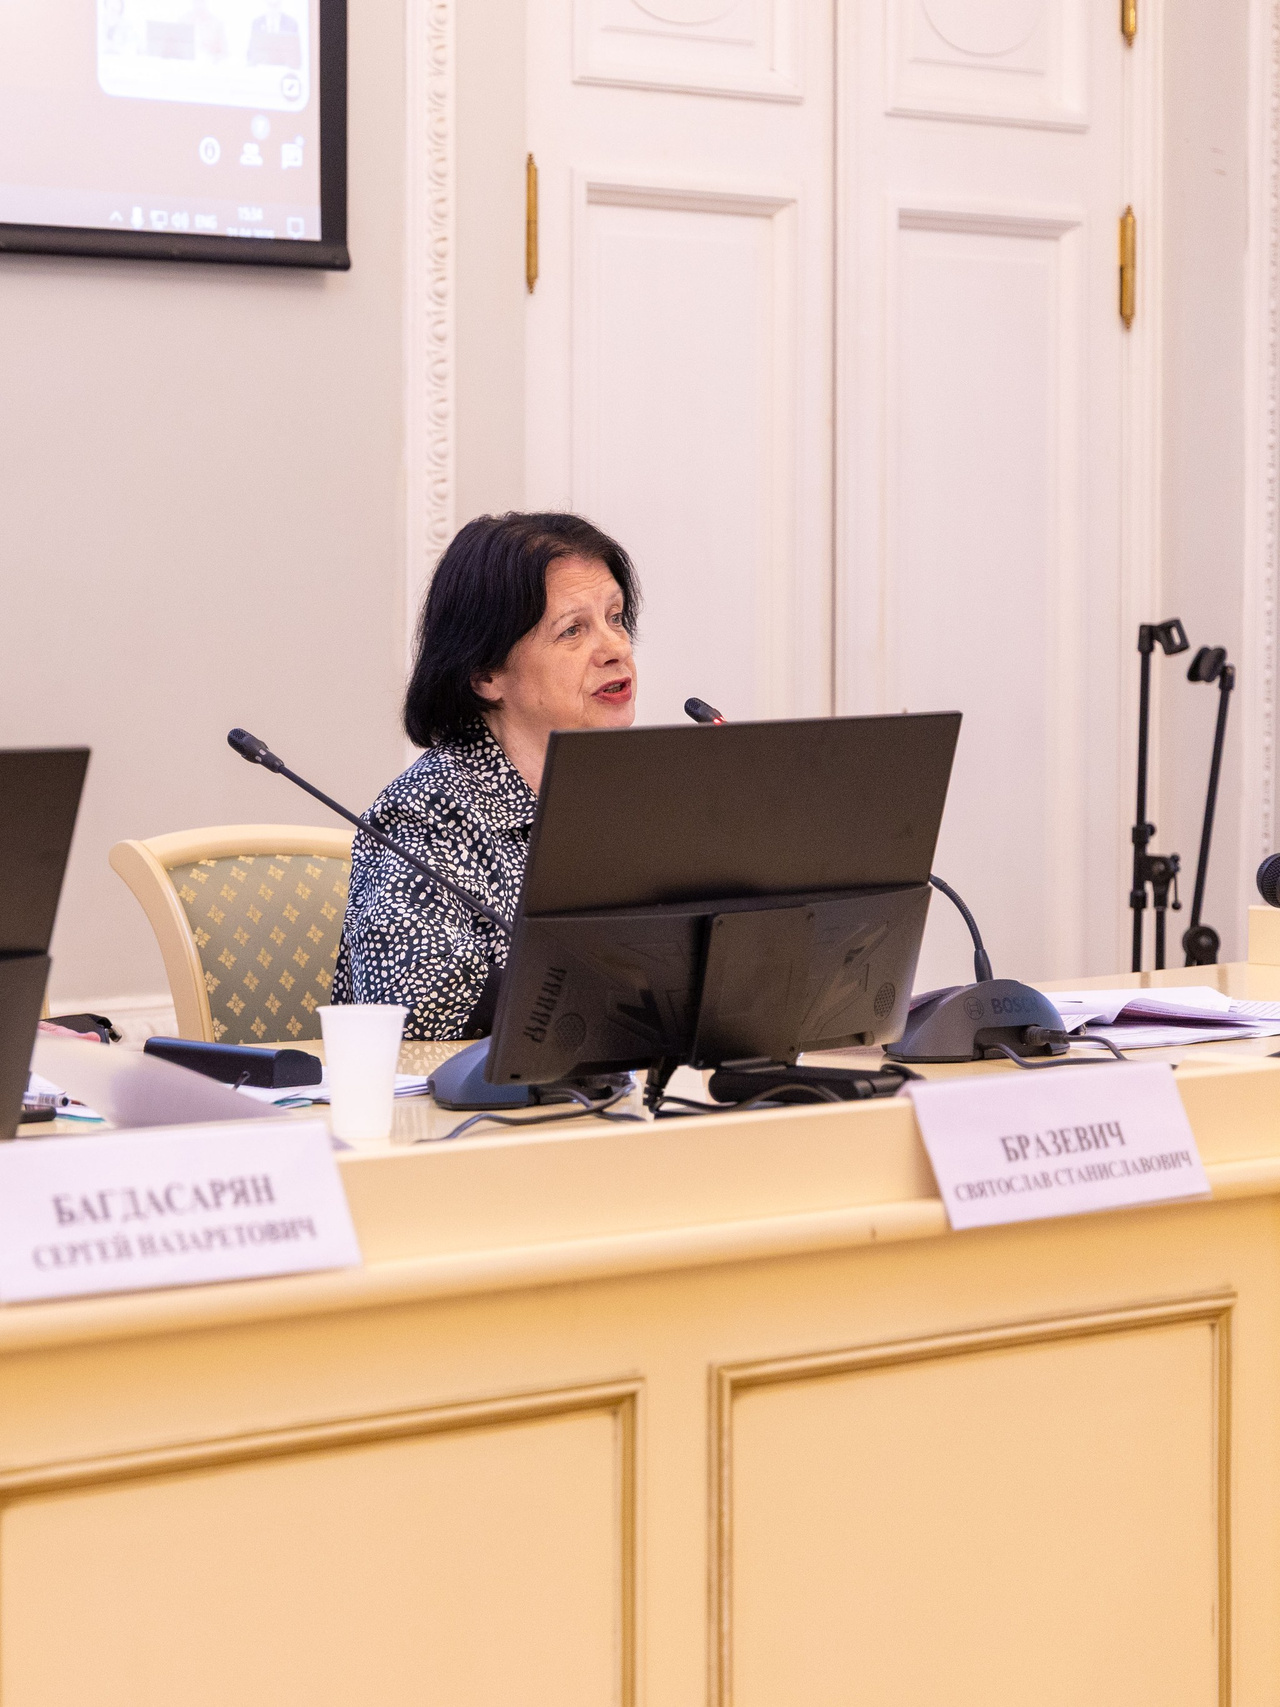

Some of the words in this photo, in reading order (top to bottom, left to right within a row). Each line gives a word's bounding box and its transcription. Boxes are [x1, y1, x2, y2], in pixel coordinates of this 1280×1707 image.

[991, 996, 1038, 1014] BOSCH
[1000, 1121, 1127, 1163] БРАЗЕВИЧ
[52, 1173, 276, 1226] БАГДАСАРЯН
[954, 1169, 1054, 1202] СВЯТОСЛАВ
[1053, 1149, 1194, 1188] СТАНИСЛАВОВИЧ
[32, 1238, 135, 1271] СЕРГЕЙ
[139, 1216, 319, 1256] НАЗАРЕТОВИЧ
